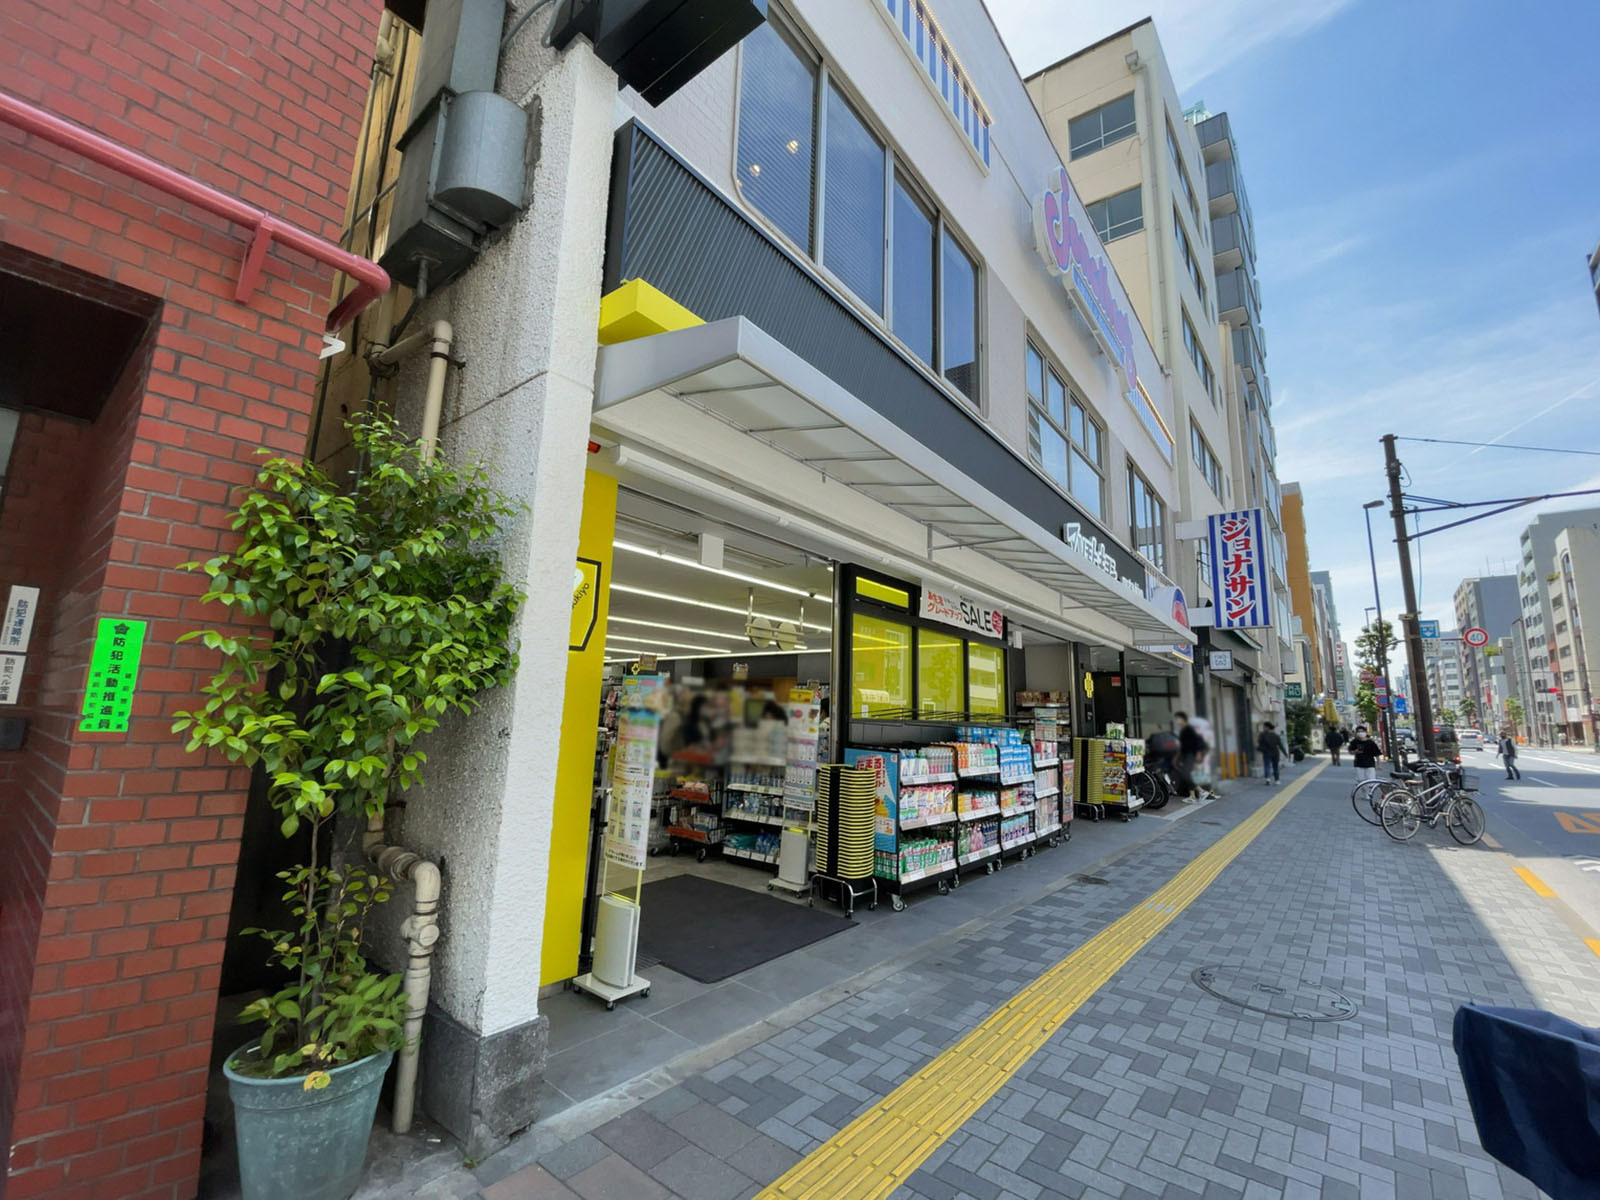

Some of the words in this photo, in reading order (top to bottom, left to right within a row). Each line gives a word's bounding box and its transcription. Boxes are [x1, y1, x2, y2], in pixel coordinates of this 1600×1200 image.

[1222, 517, 1257, 621] ジョナサン
[959, 601, 993, 633] SALE
[97, 637, 126, 729] 防犯活動推進員
